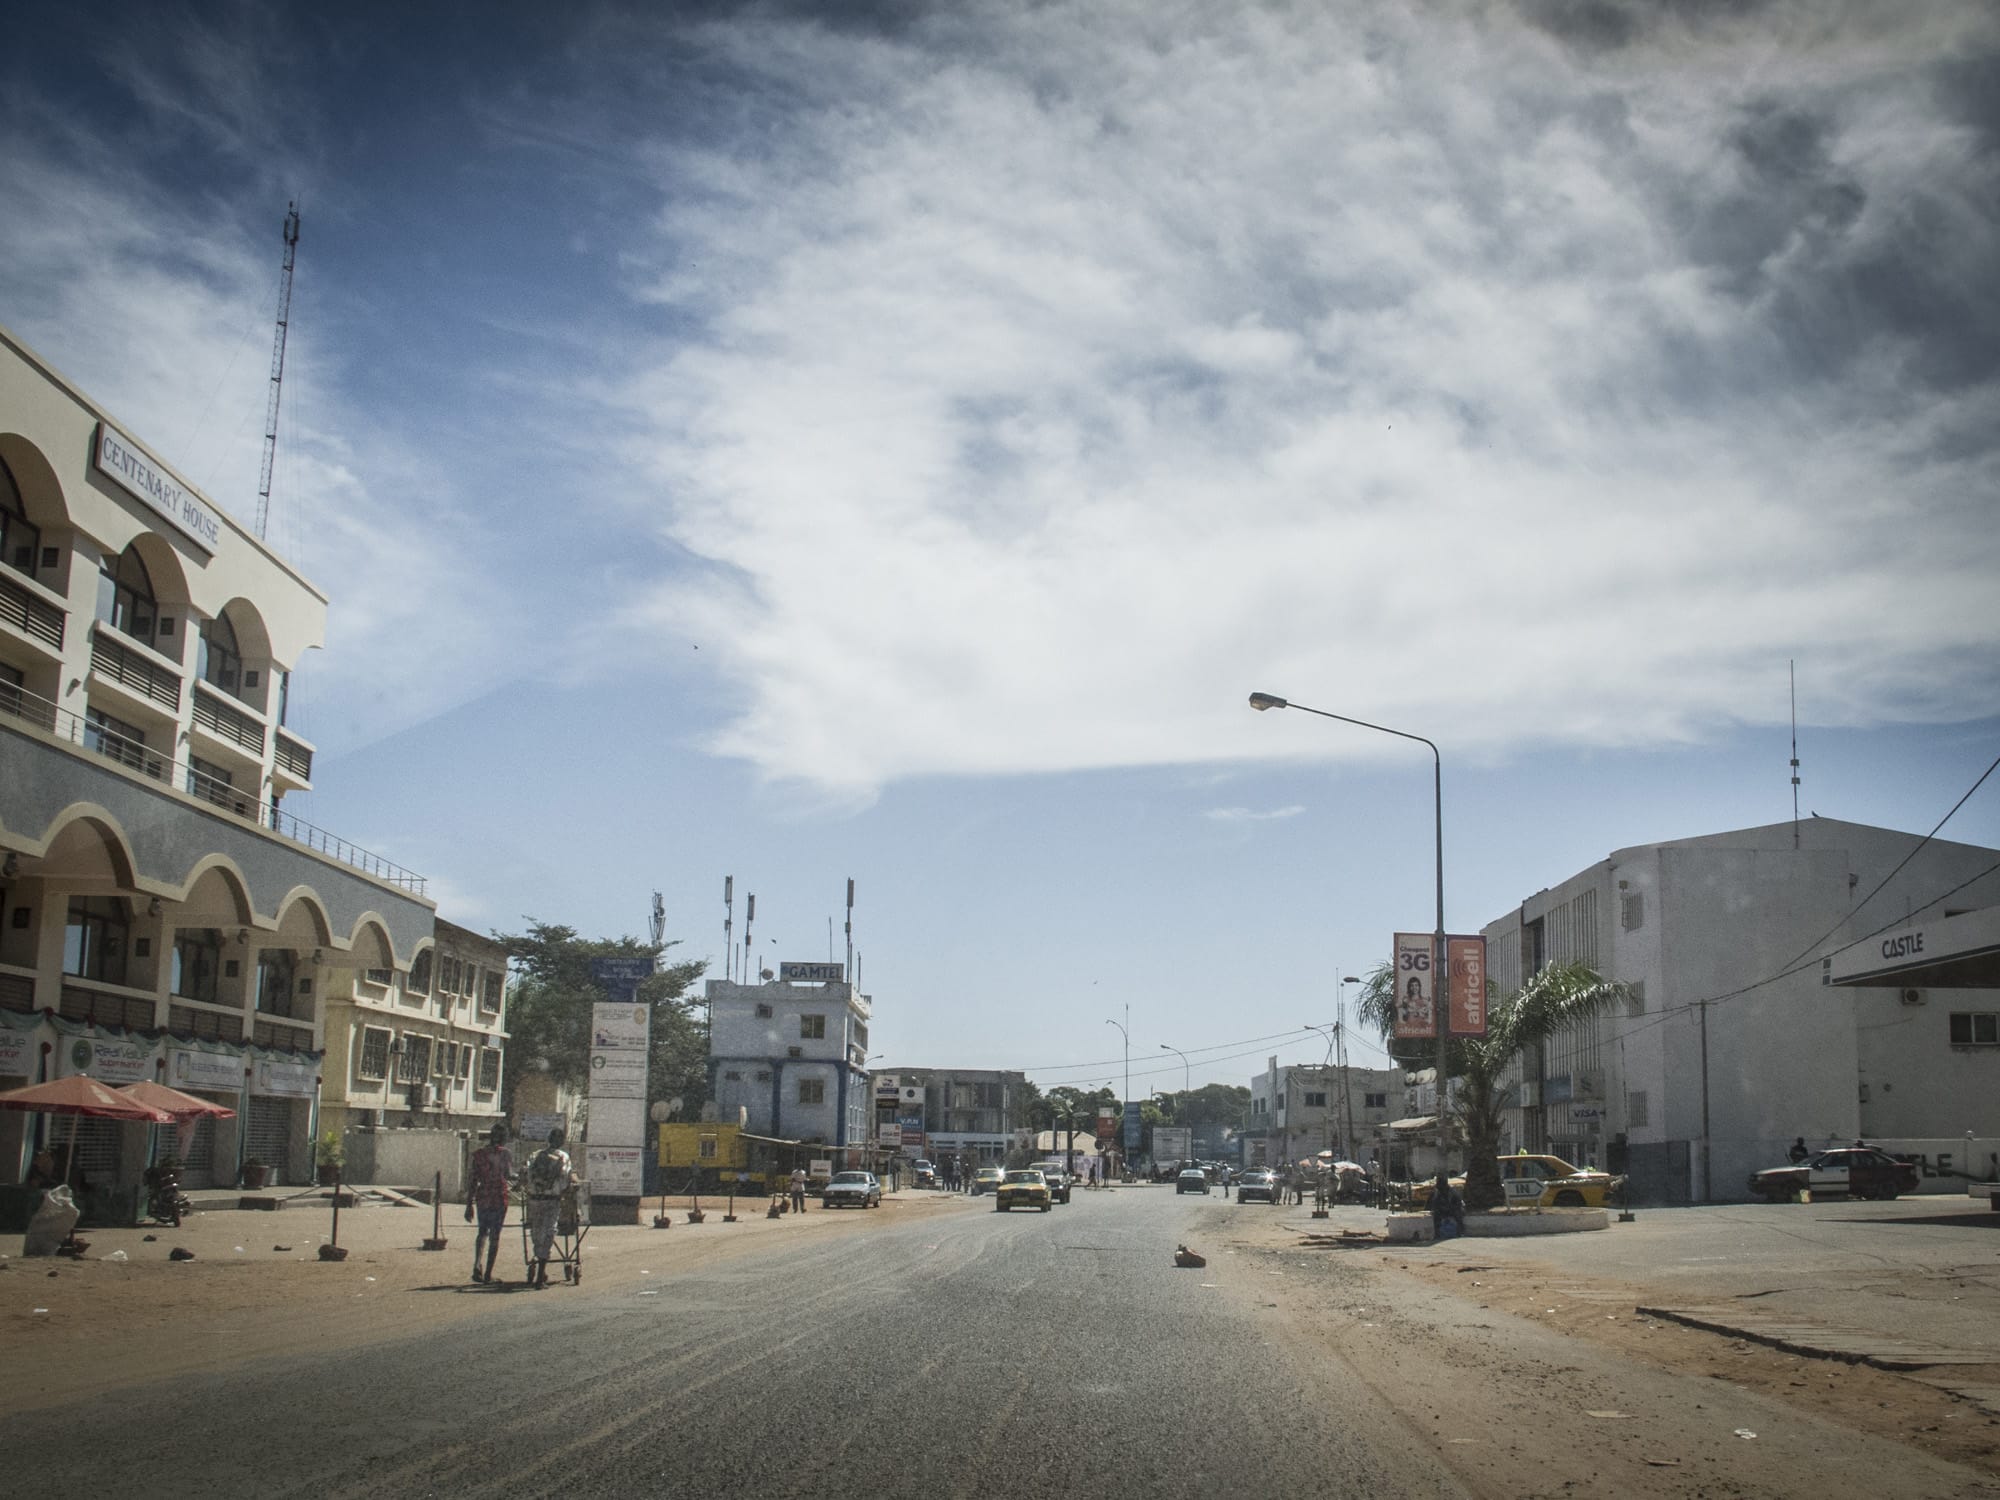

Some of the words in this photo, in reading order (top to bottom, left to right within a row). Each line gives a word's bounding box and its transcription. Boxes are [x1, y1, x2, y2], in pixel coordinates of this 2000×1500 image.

[103, 437, 181, 513] CENTENARY
[183, 500, 219, 544] HOUSE
[1882, 932, 1923, 959] CASTLE
[1400, 953, 1431, 971] 3G
[788, 966, 842, 979] GAMTEL
[1463, 948, 1480, 1025] africell
[1574, 1109, 1598, 1118] VISA
[1516, 1184, 1530, 1194] IN
